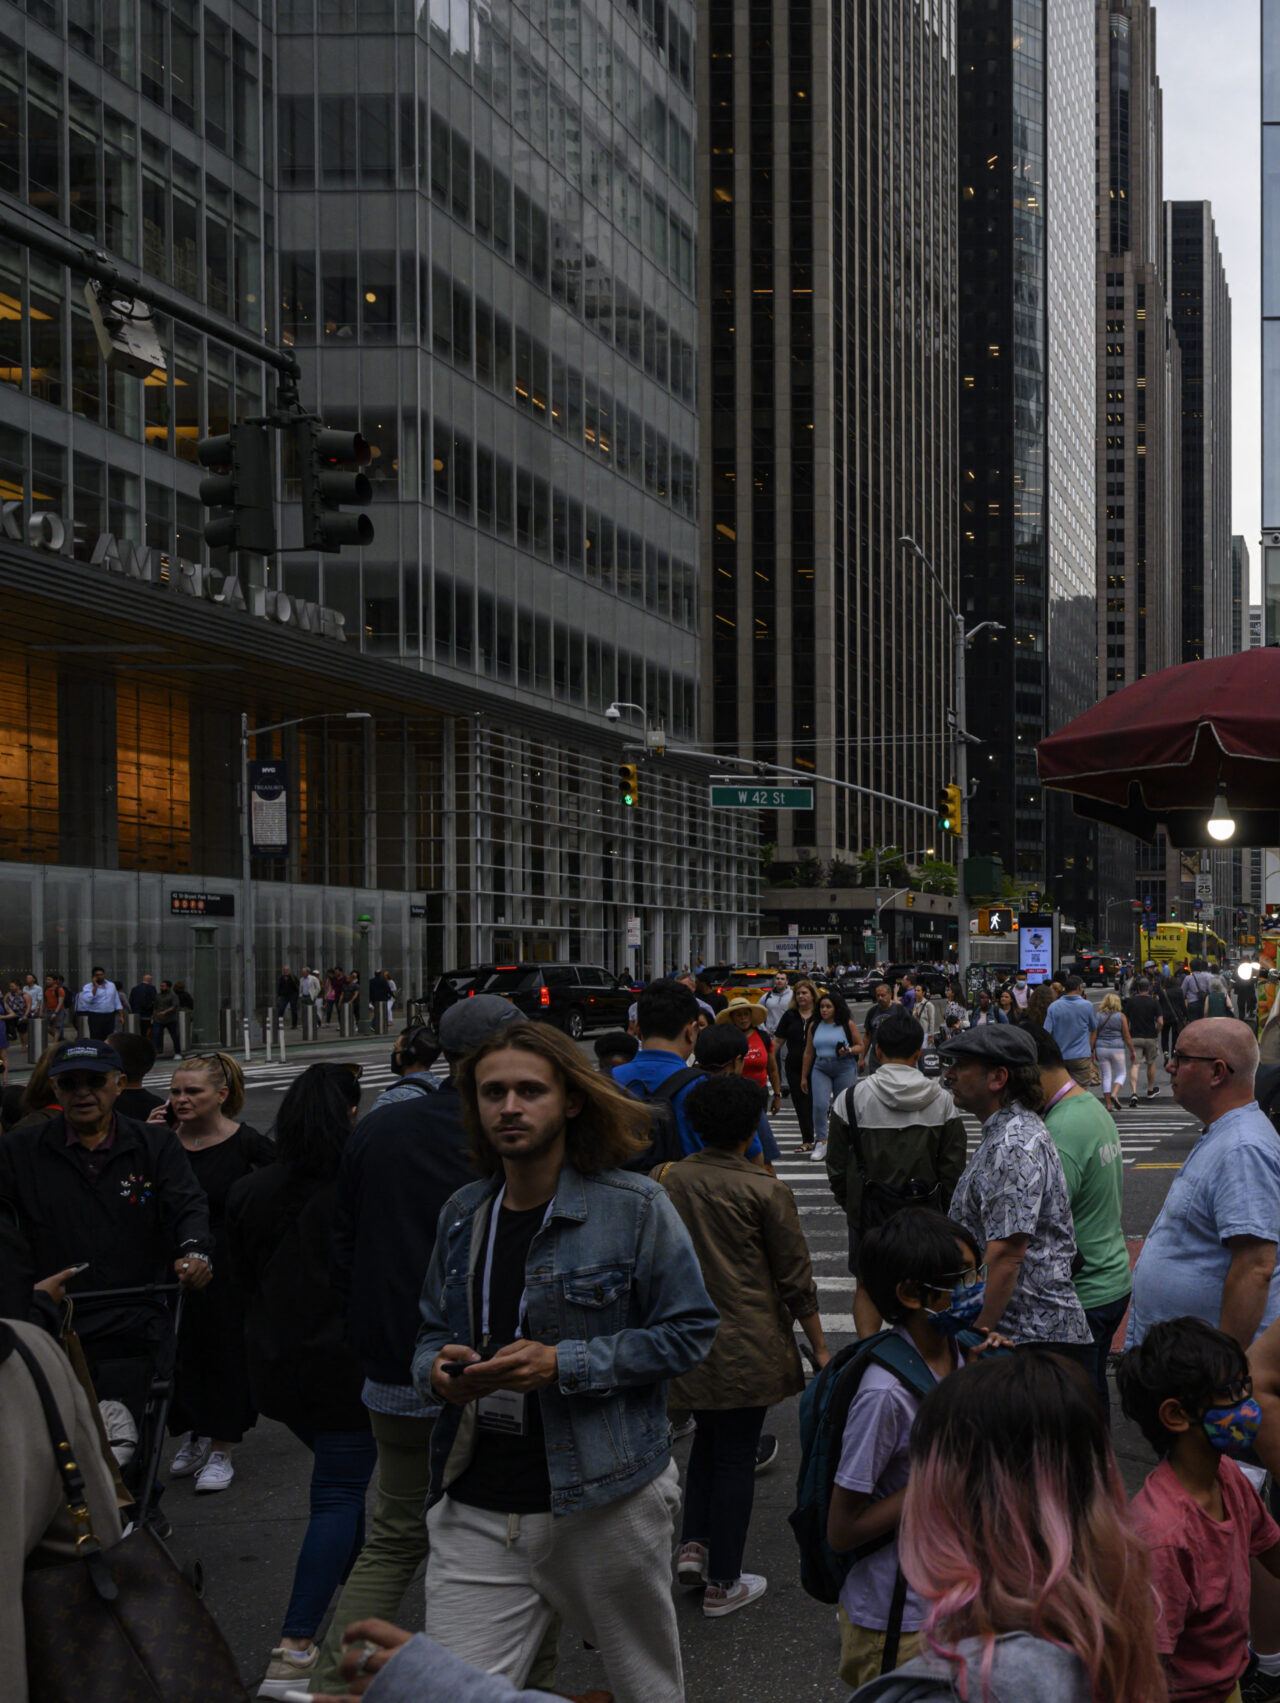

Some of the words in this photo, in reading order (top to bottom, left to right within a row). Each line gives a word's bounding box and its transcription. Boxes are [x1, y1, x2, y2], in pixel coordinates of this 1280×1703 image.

[248, 584, 347, 643] TOWER
[737, 791, 747, 804] W
[752, 791, 768, 804] 42
[773, 792, 785, 804] St
[1198, 885, 1211, 893] 25
